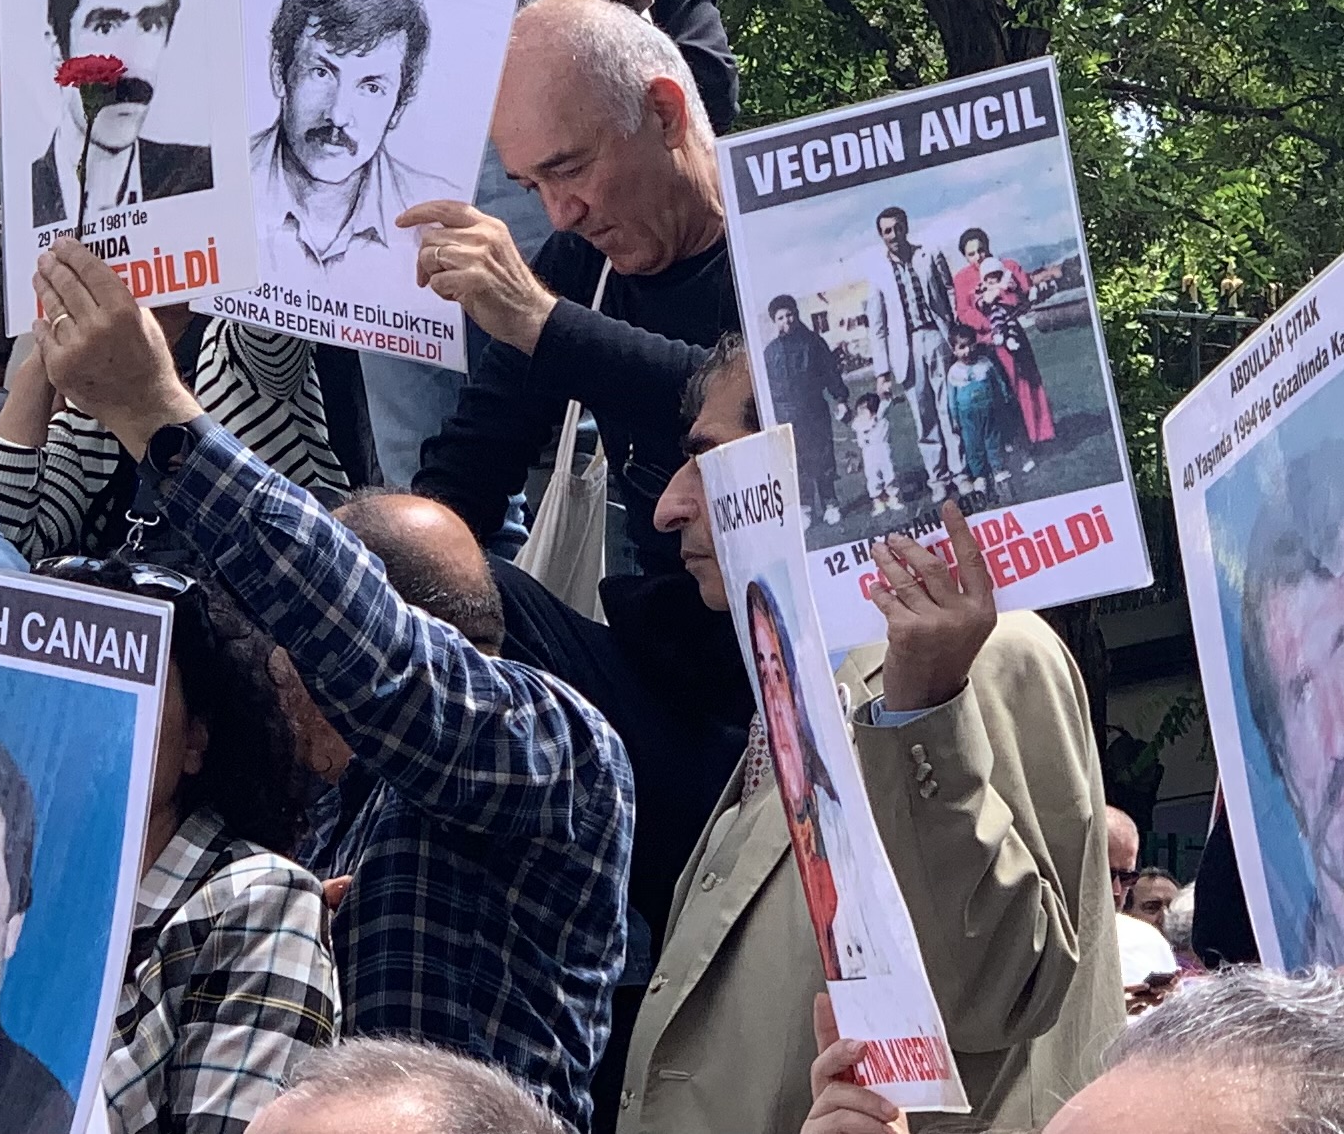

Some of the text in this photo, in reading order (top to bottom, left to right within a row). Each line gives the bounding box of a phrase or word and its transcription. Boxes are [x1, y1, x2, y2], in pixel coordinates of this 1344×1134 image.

[919, 86, 1046, 157] AVCIL
[37, 230, 51, 248] 29
[213, 295, 443, 362] SONRA BEDENİ KAYBEDİLDİ
[306, 289, 349, 319] İDAM
[353, 303, 455, 341] EDİLDİKTEN
[1285, 295, 1321, 353] ÇITAK
[1194, 432, 1233, 479] Yaşında
[1272, 345, 1330, 409] Gözaltında
[741, 473, 784, 528] KURİŞ
[823, 550, 850, 577] 12
[20, 611, 149, 674] CANAN
